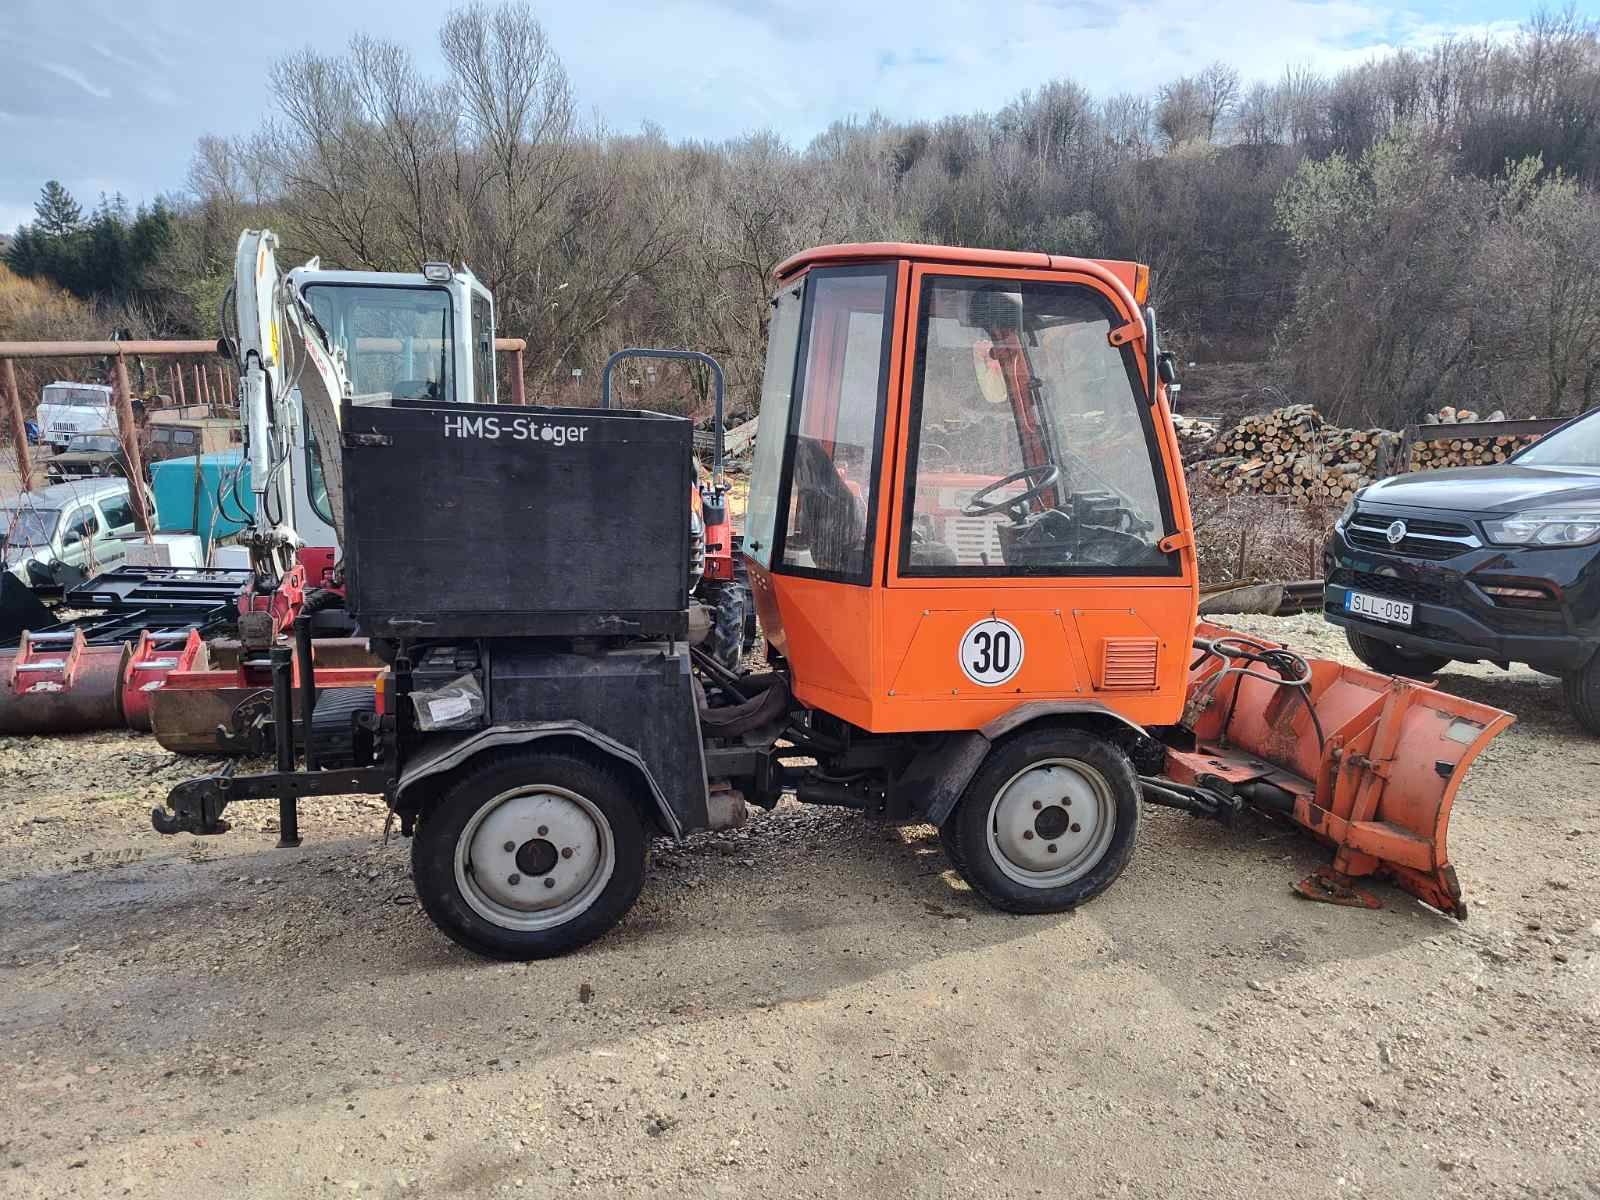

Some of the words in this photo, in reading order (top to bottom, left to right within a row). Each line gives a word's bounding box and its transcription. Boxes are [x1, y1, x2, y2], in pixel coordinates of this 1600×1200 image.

[444, 415, 588, 446] HMS-Stöger
[1353, 595, 1409, 621] SLL-095
[973, 630, 1011, 674] 30
